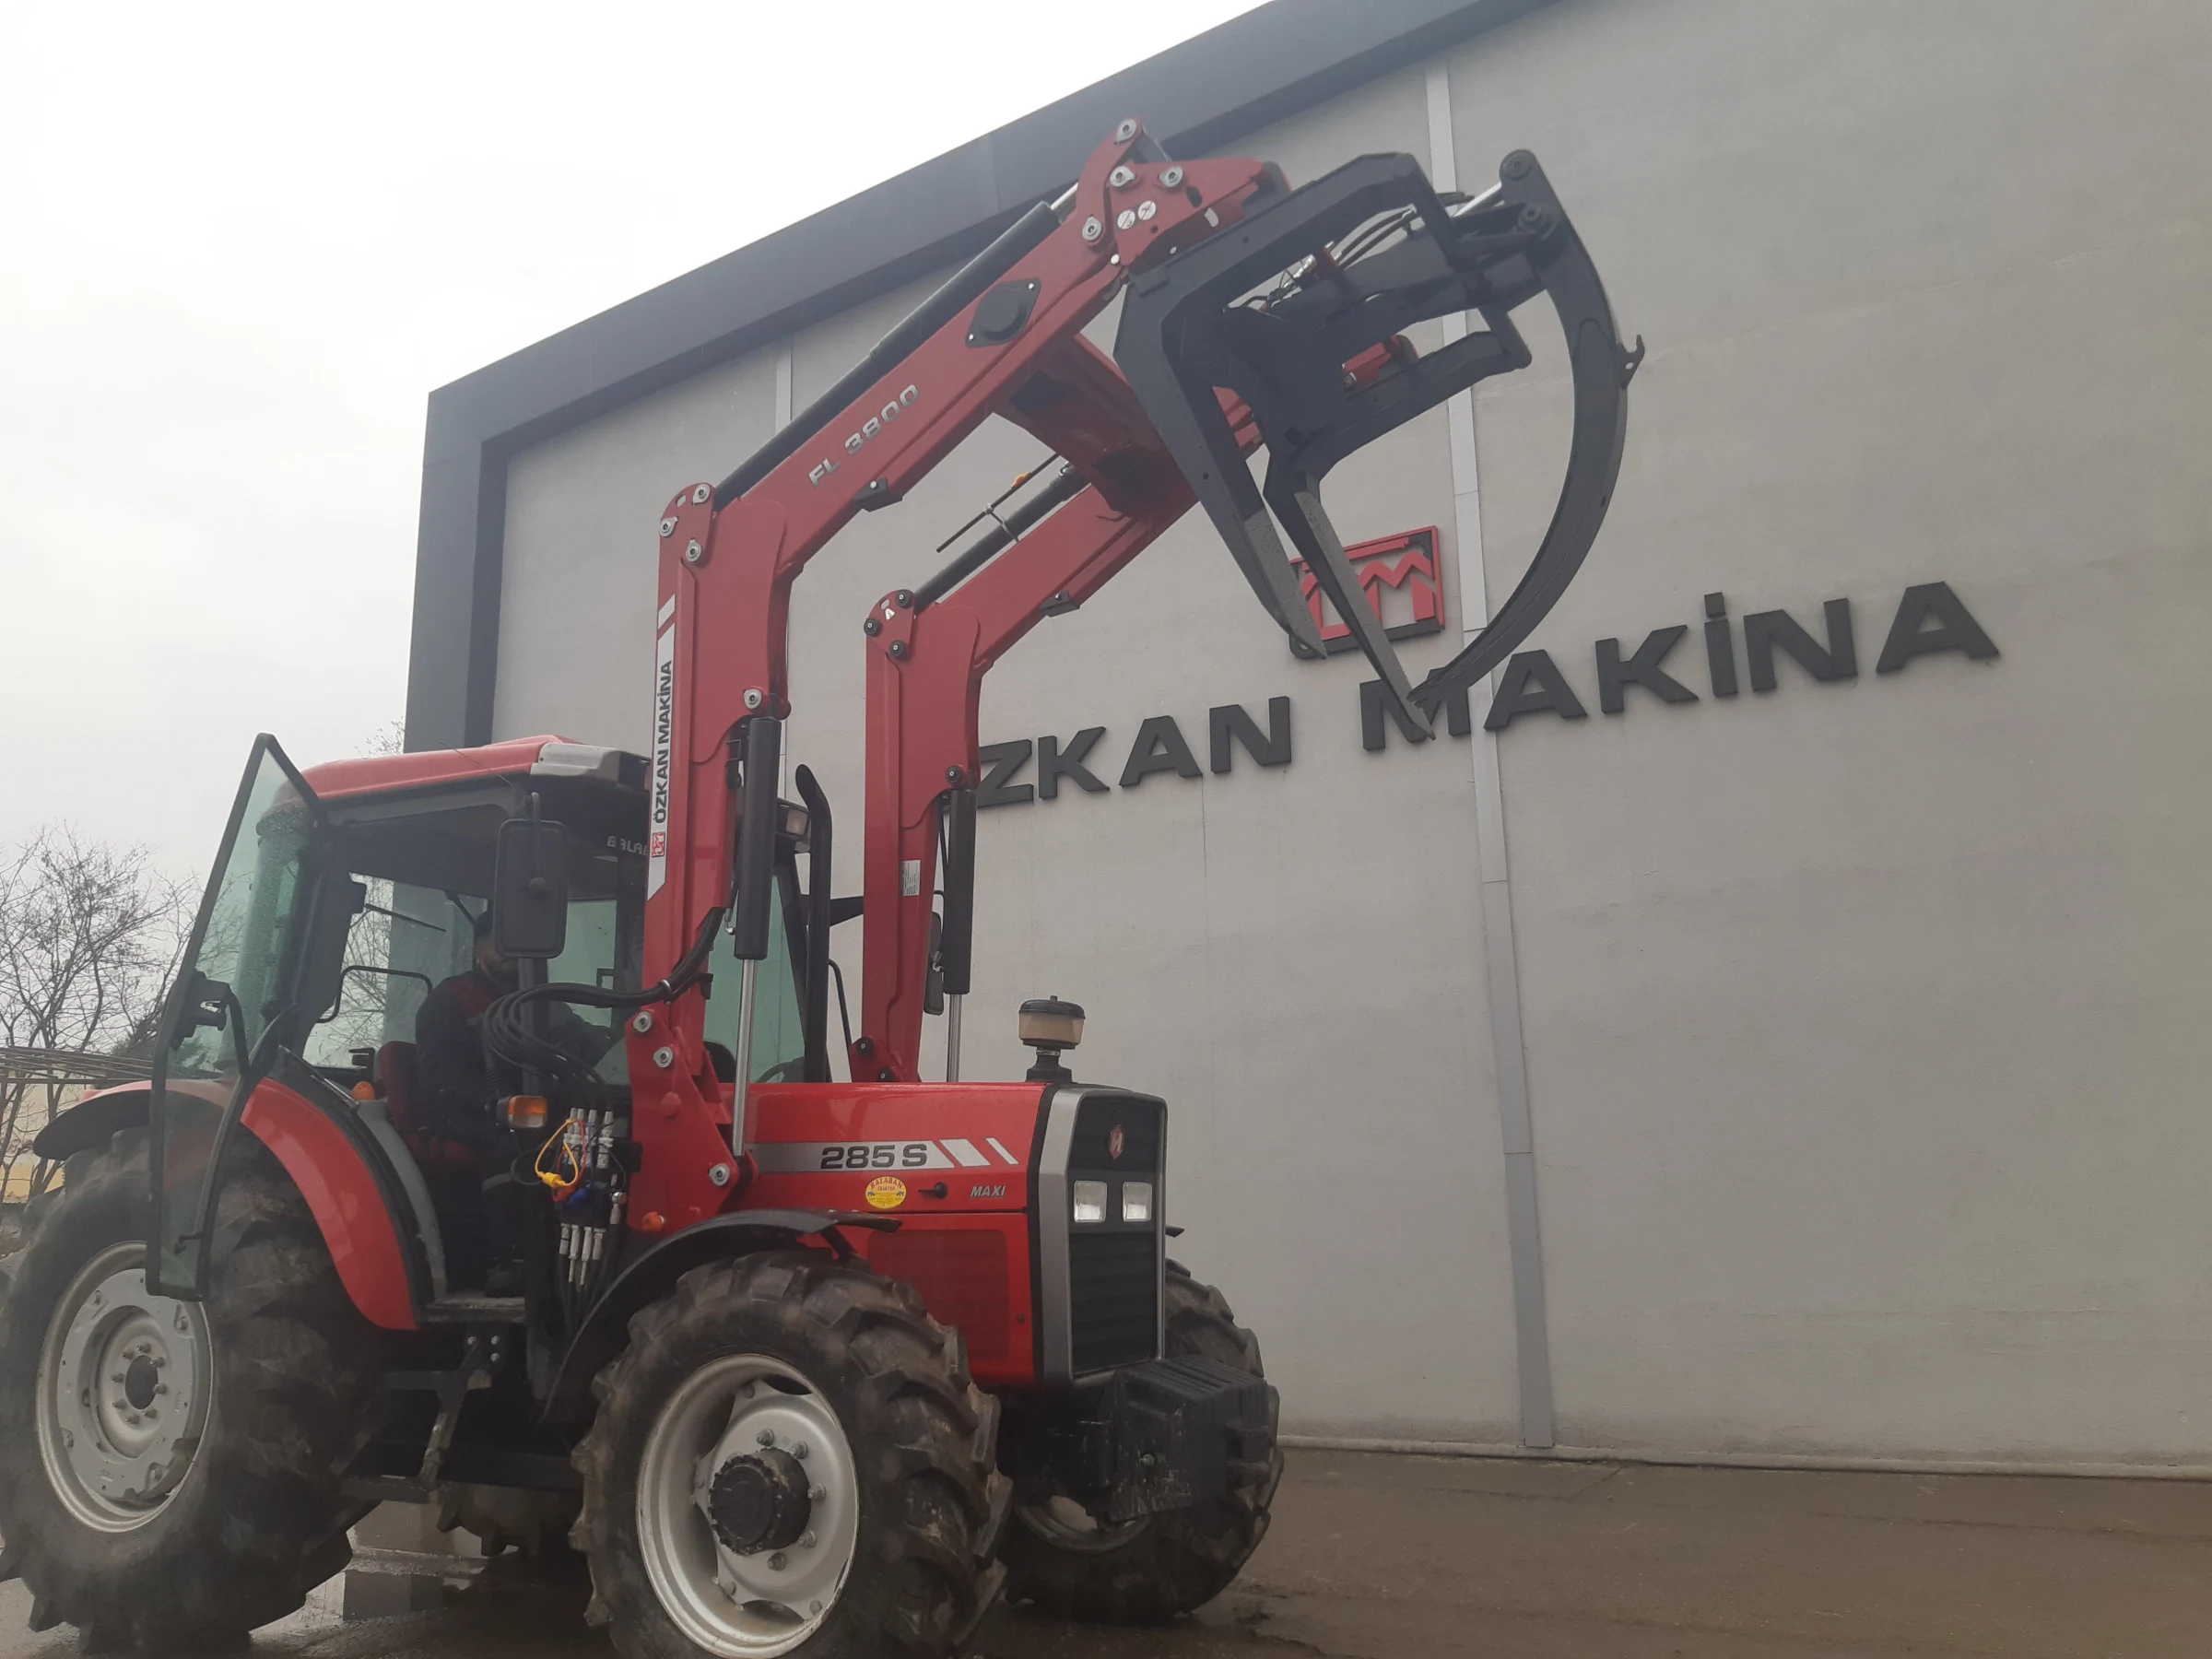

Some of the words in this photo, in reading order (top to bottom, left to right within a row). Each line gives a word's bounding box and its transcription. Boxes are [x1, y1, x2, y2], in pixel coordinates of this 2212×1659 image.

[808, 458, 841, 488] FL
[844, 383, 920, 456] 3800
[657, 660, 672, 744] MAKİNA
[653, 749, 669, 823] ÖZKAN
[977, 695, 1292, 809] ZKAN
[971, 1185, 1006, 1197] MAXI
